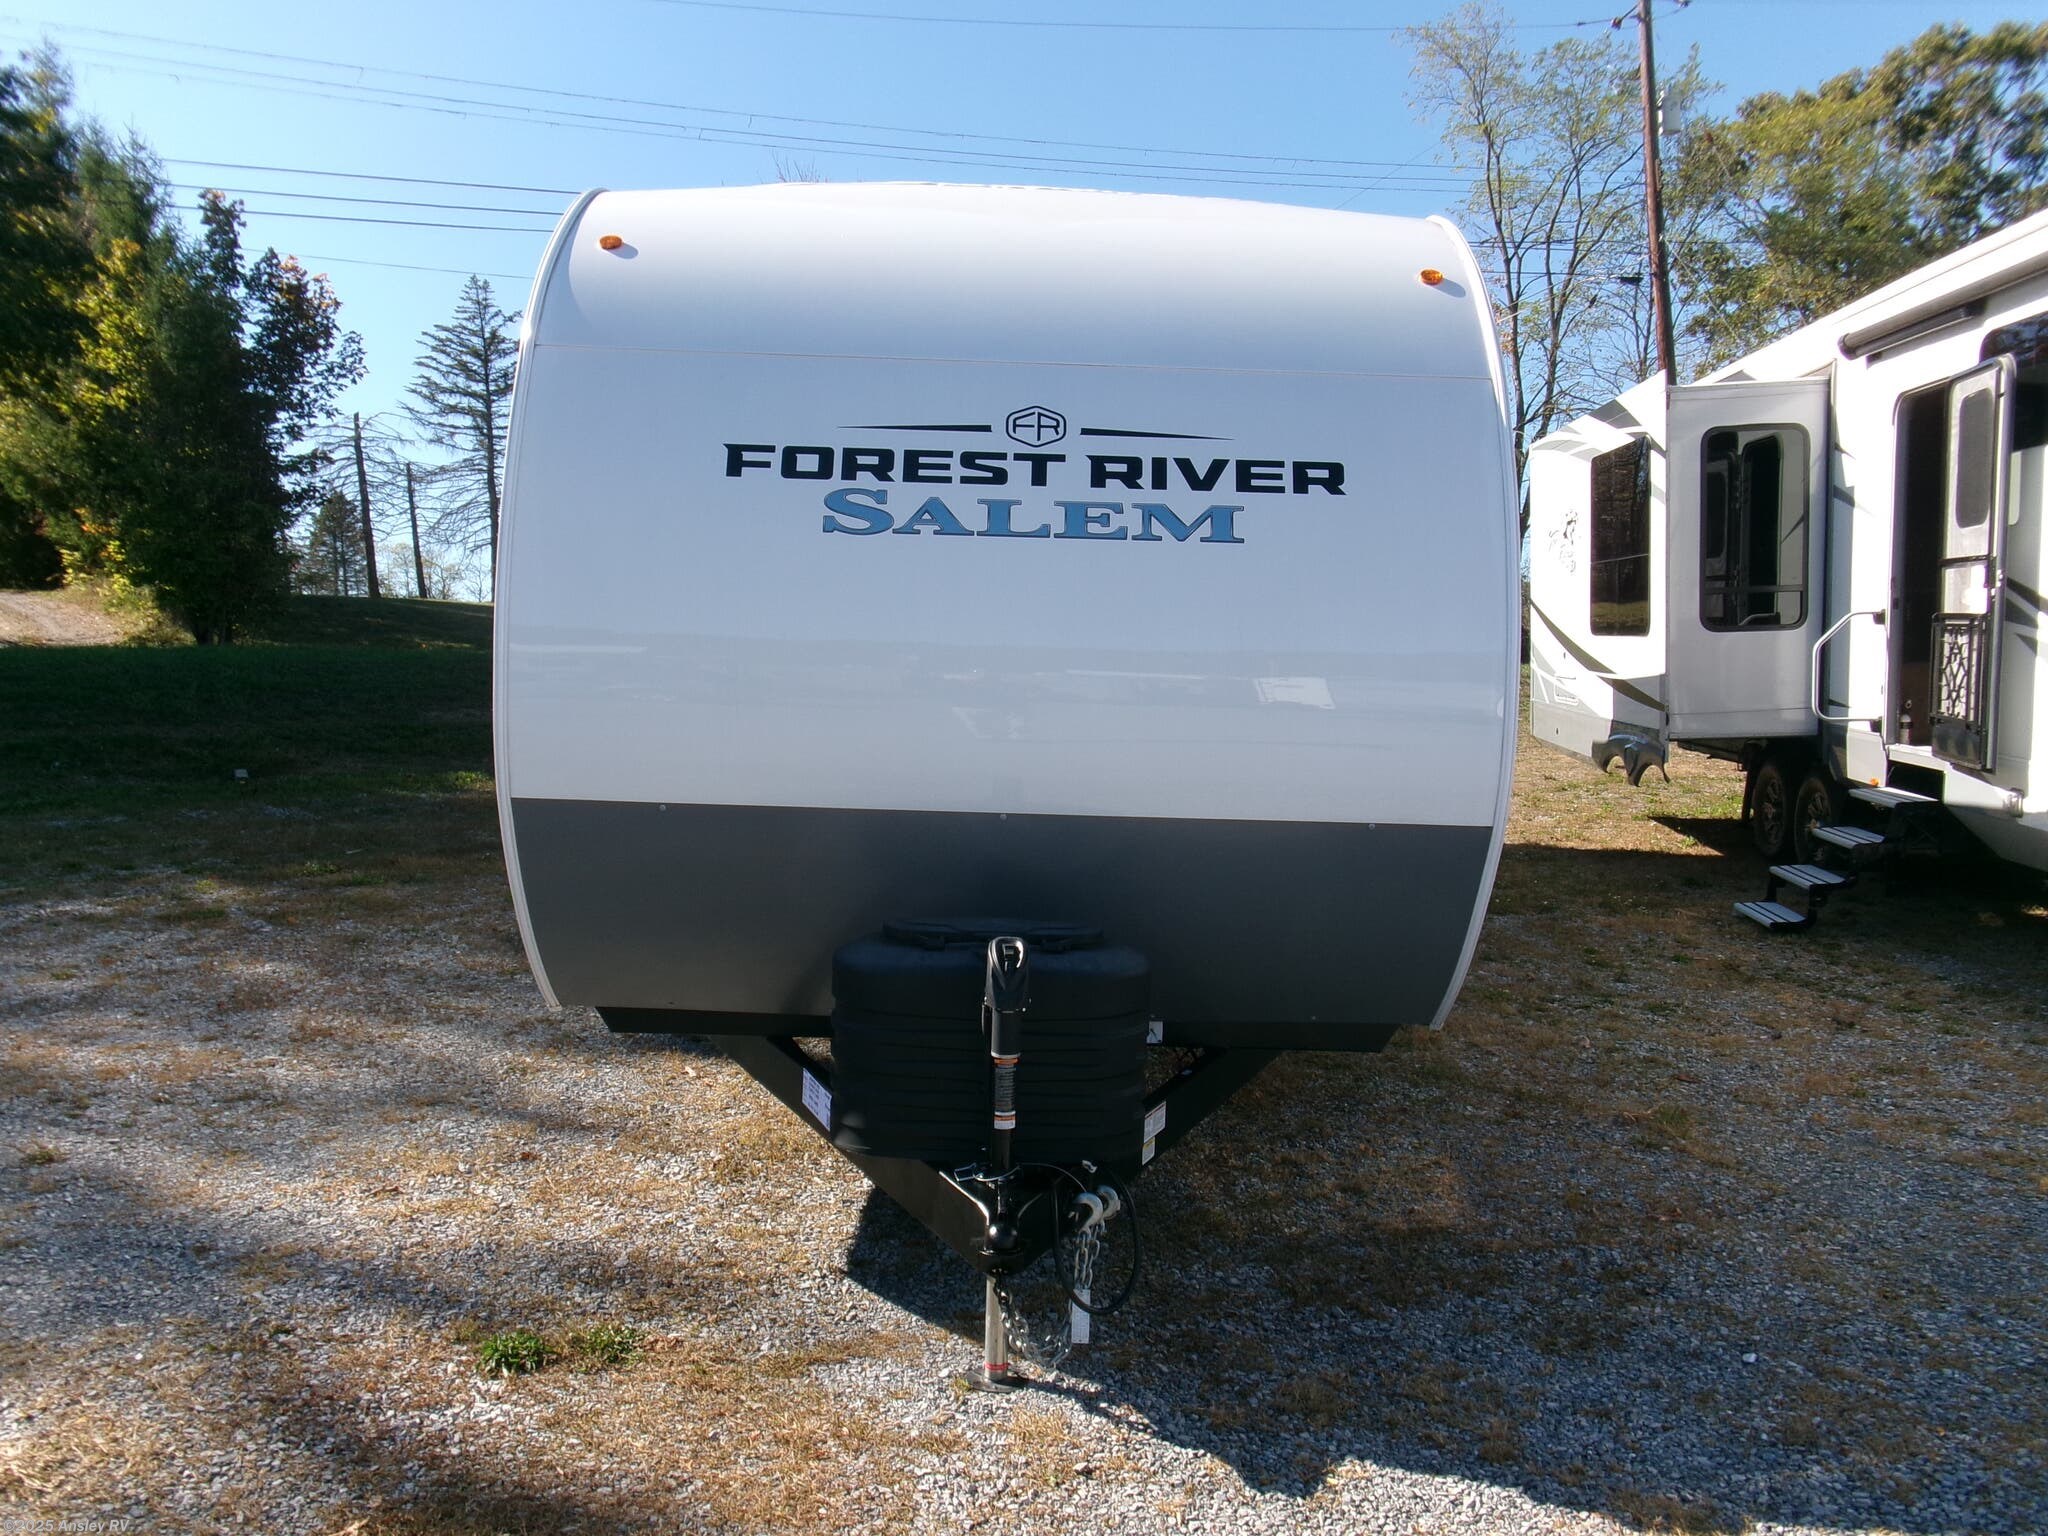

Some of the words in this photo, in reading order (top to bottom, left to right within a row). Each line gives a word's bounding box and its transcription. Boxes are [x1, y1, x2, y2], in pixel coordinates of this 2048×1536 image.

[1011, 410, 1062, 443] FR
[723, 444, 1067, 487] FOREST
[1086, 455, 1347, 496] RIVER
[822, 487, 1245, 544] SALEM
